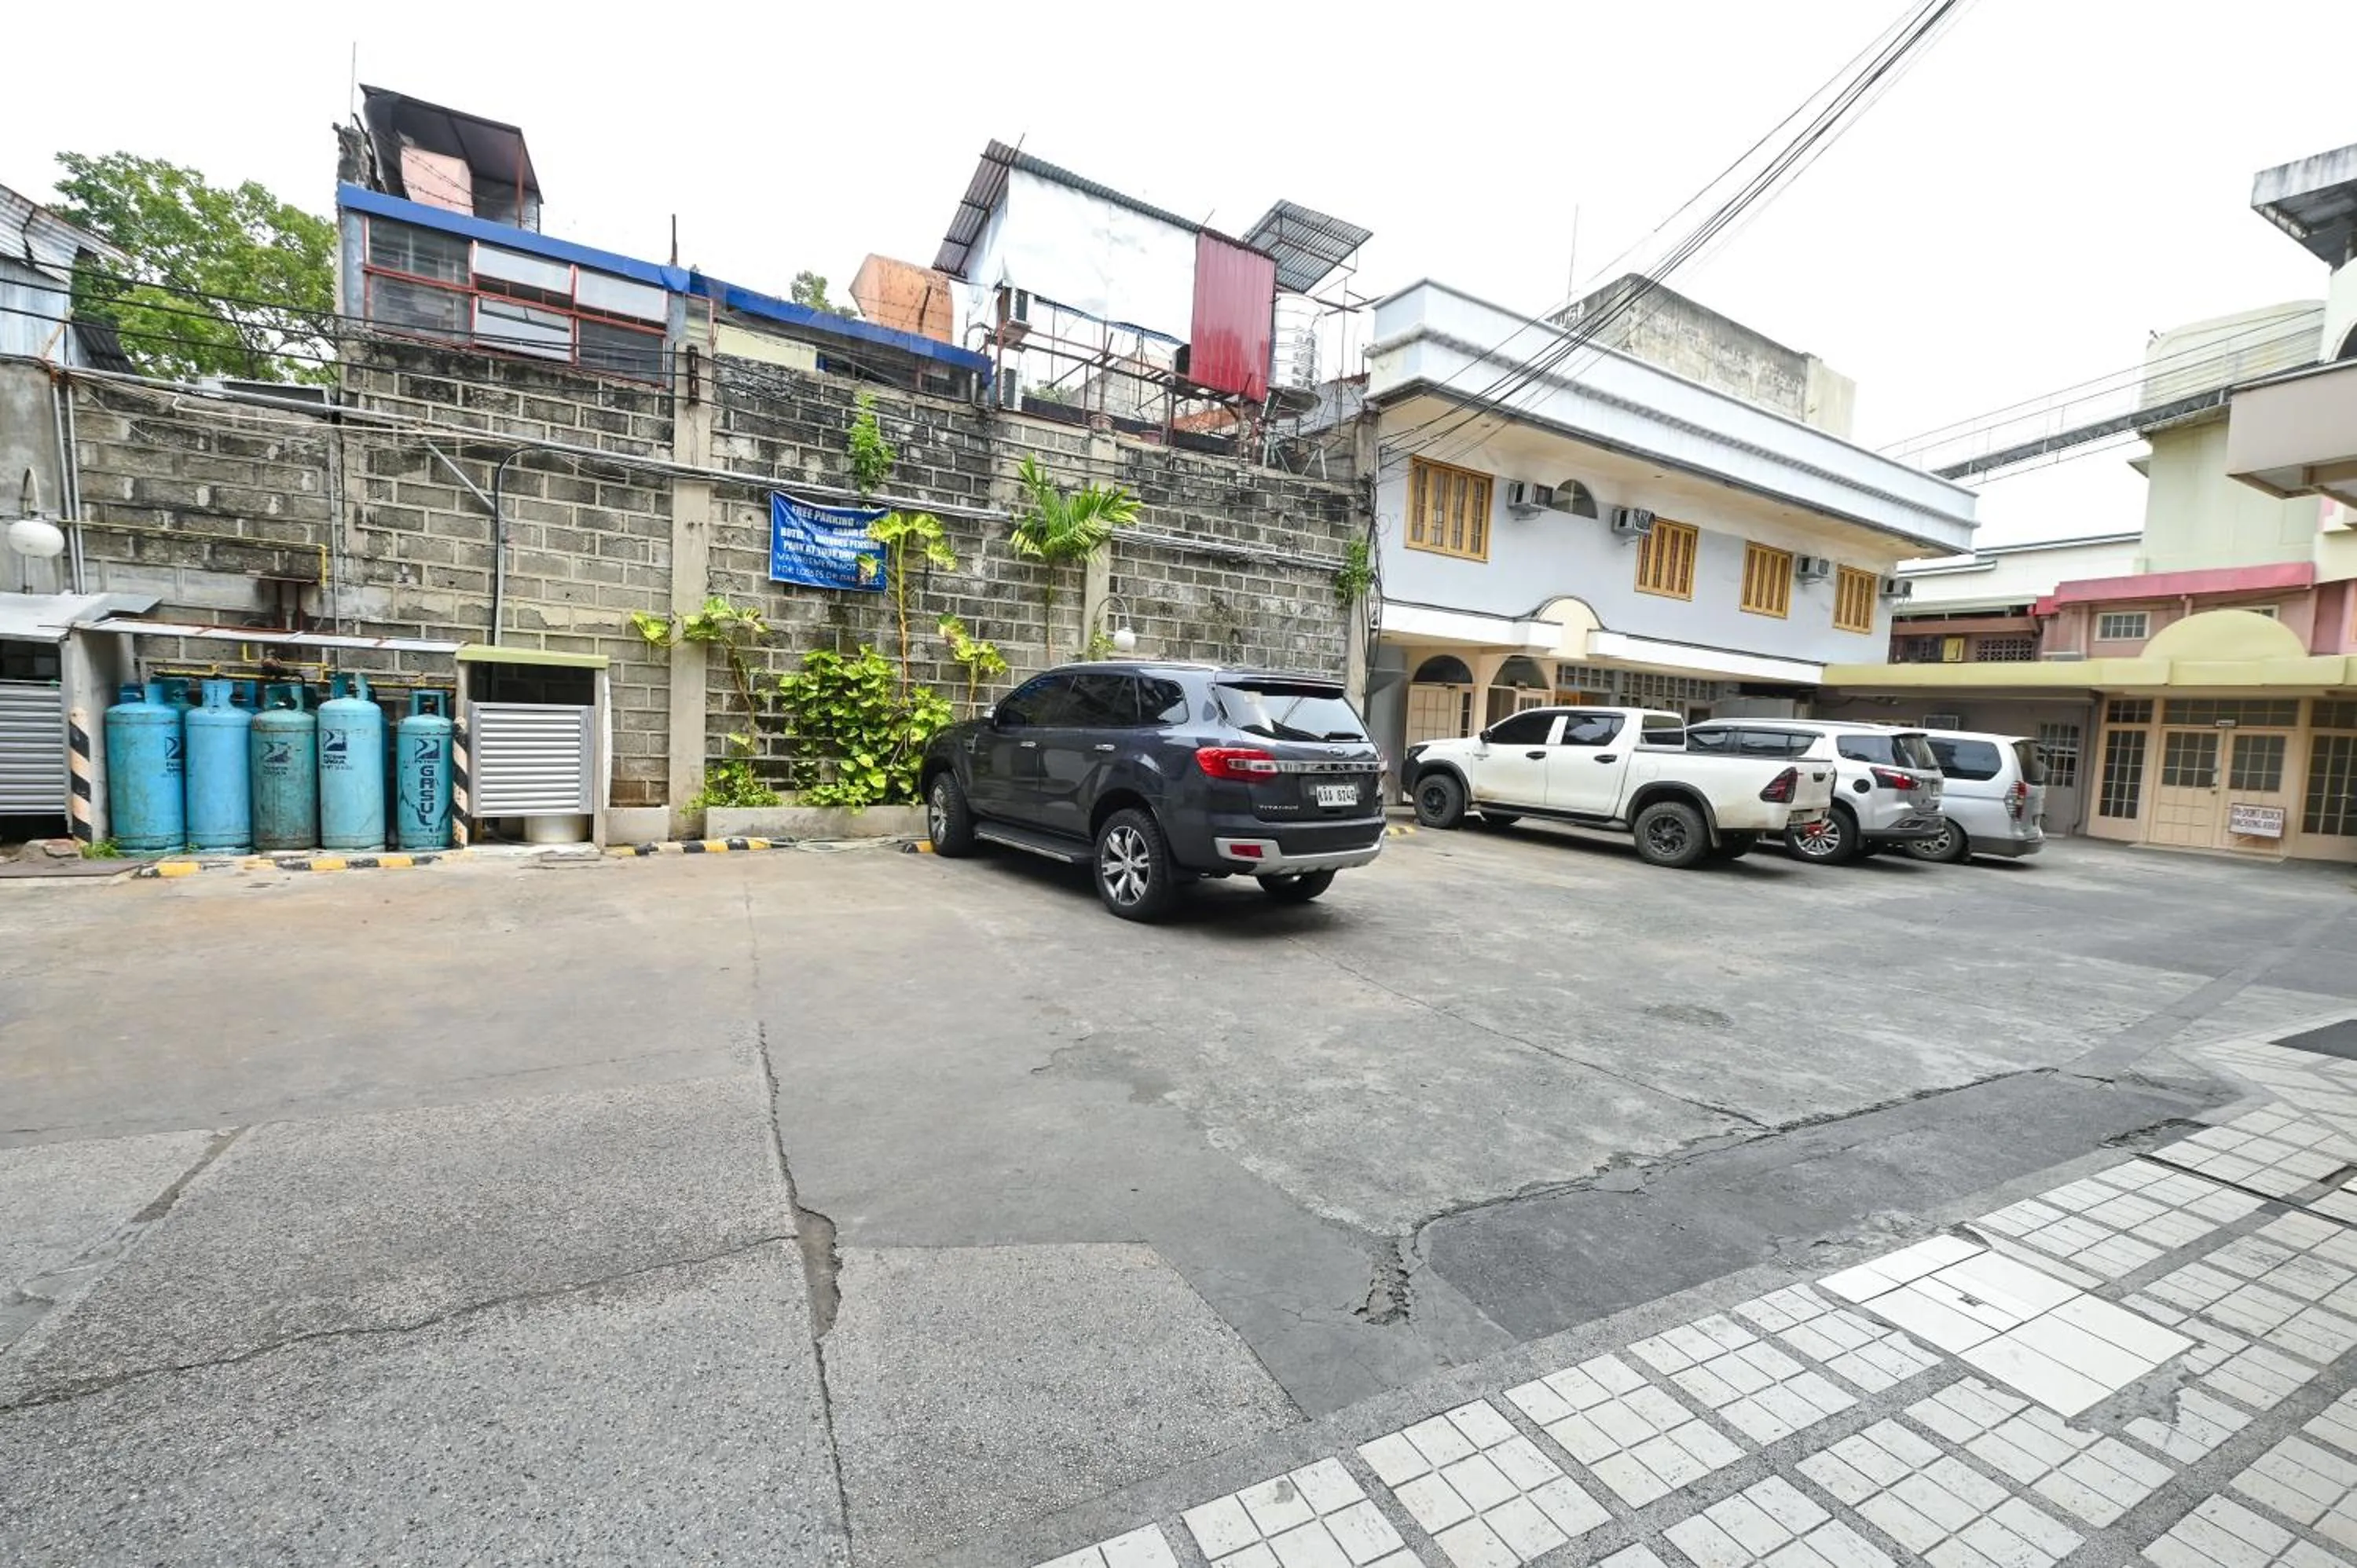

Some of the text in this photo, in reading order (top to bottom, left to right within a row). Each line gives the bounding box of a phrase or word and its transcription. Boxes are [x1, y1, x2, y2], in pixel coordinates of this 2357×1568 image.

[792, 504, 813, 519] FREE
[813, 510, 854, 527] PARKING
[780, 526, 805, 540] HOTEL
[783, 540, 805, 552] PARK
[805, 544, 816, 555] AT
[777, 552, 838, 570] MANAGEMENT
[838, 562, 857, 572] NOT
[777, 566, 794, 575] FOR
[796, 567, 824, 579] LOSSES
